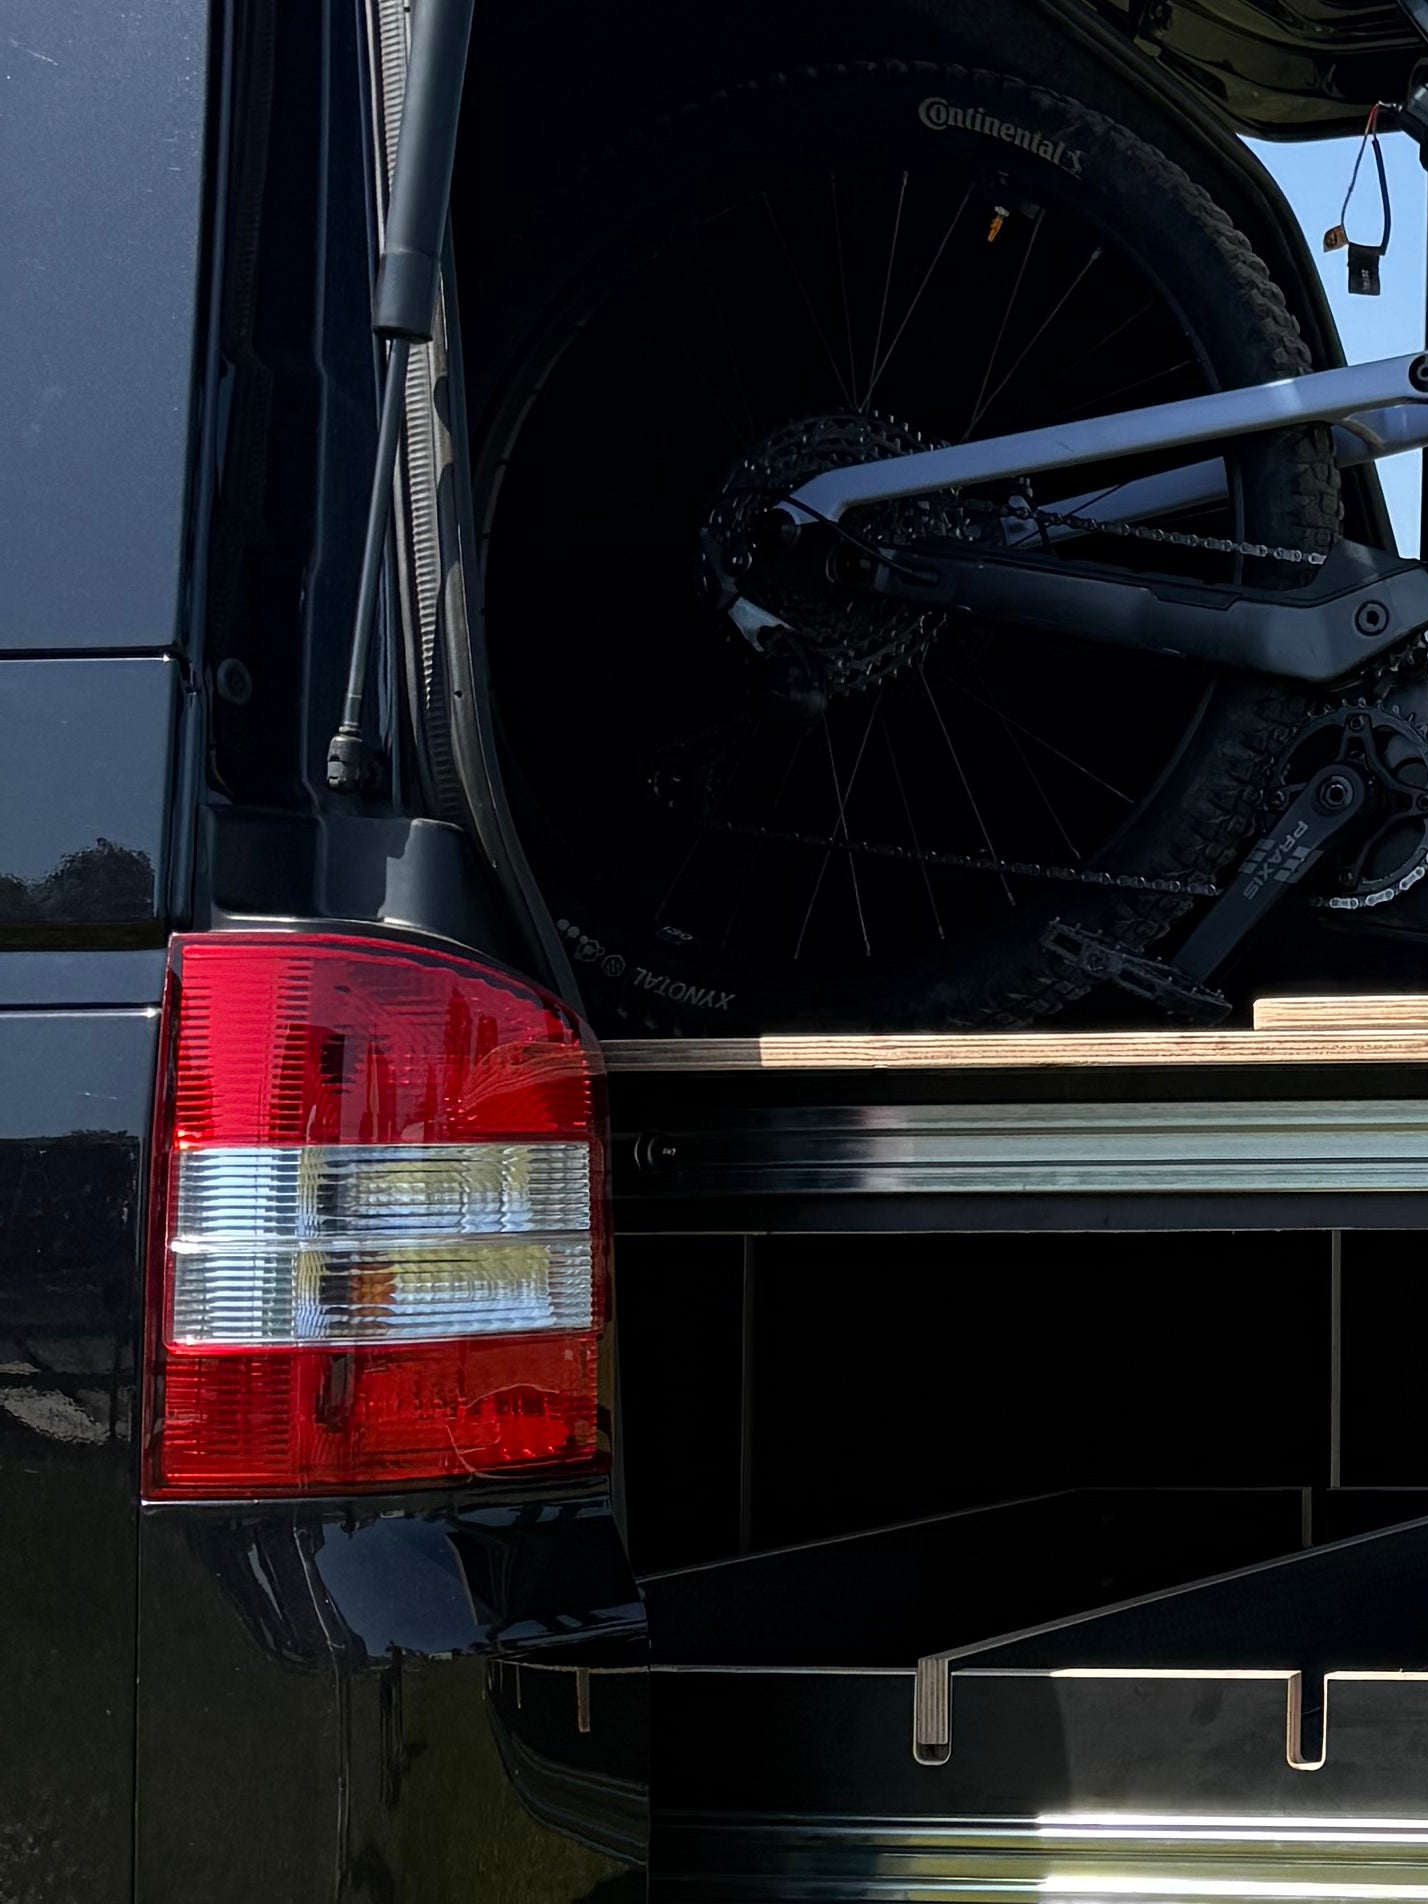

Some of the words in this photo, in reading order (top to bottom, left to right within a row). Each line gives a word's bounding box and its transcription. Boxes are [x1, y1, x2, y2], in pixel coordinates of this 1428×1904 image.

[918, 96, 1067, 166] Continental
[1242, 819, 1309, 901] PRAXIS
[633, 967, 737, 1010] XYNOTAL
